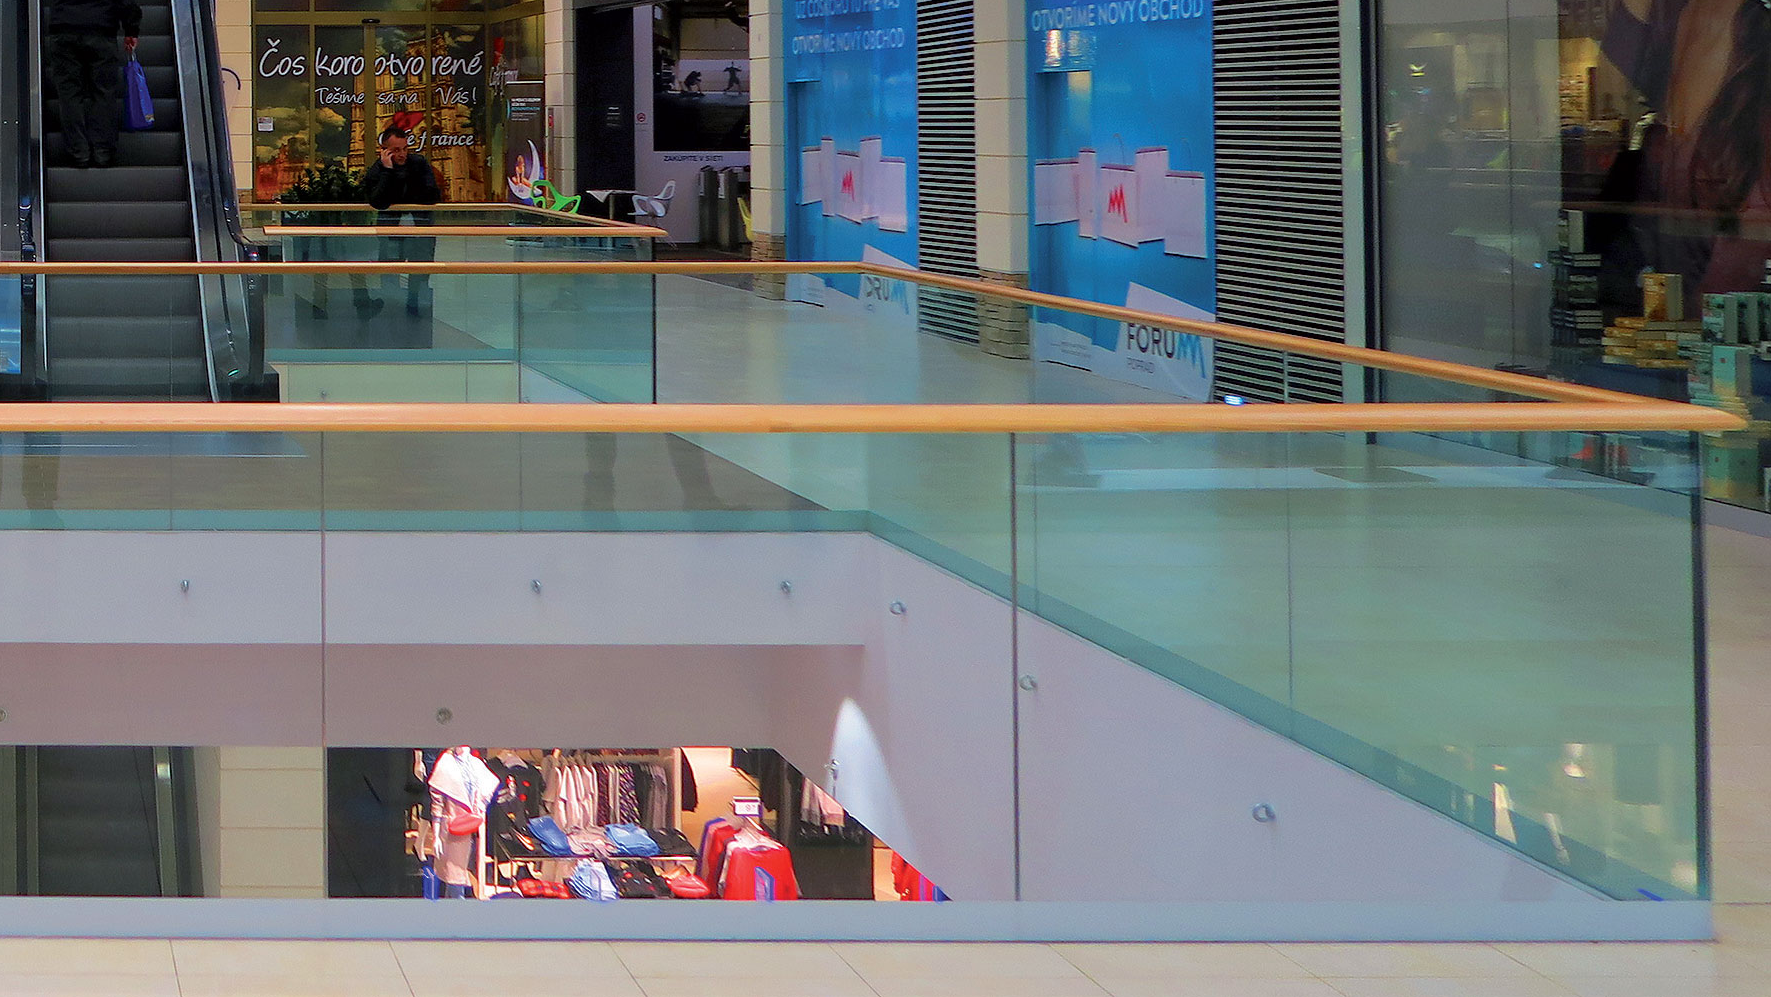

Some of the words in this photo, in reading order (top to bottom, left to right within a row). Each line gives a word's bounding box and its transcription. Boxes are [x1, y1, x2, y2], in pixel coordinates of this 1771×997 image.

[315, 85, 365, 105] Tešíme
[378, 90, 396, 105] sa
[399, 91, 419, 104] na
[1128, 322, 1206, 379] FORUM
